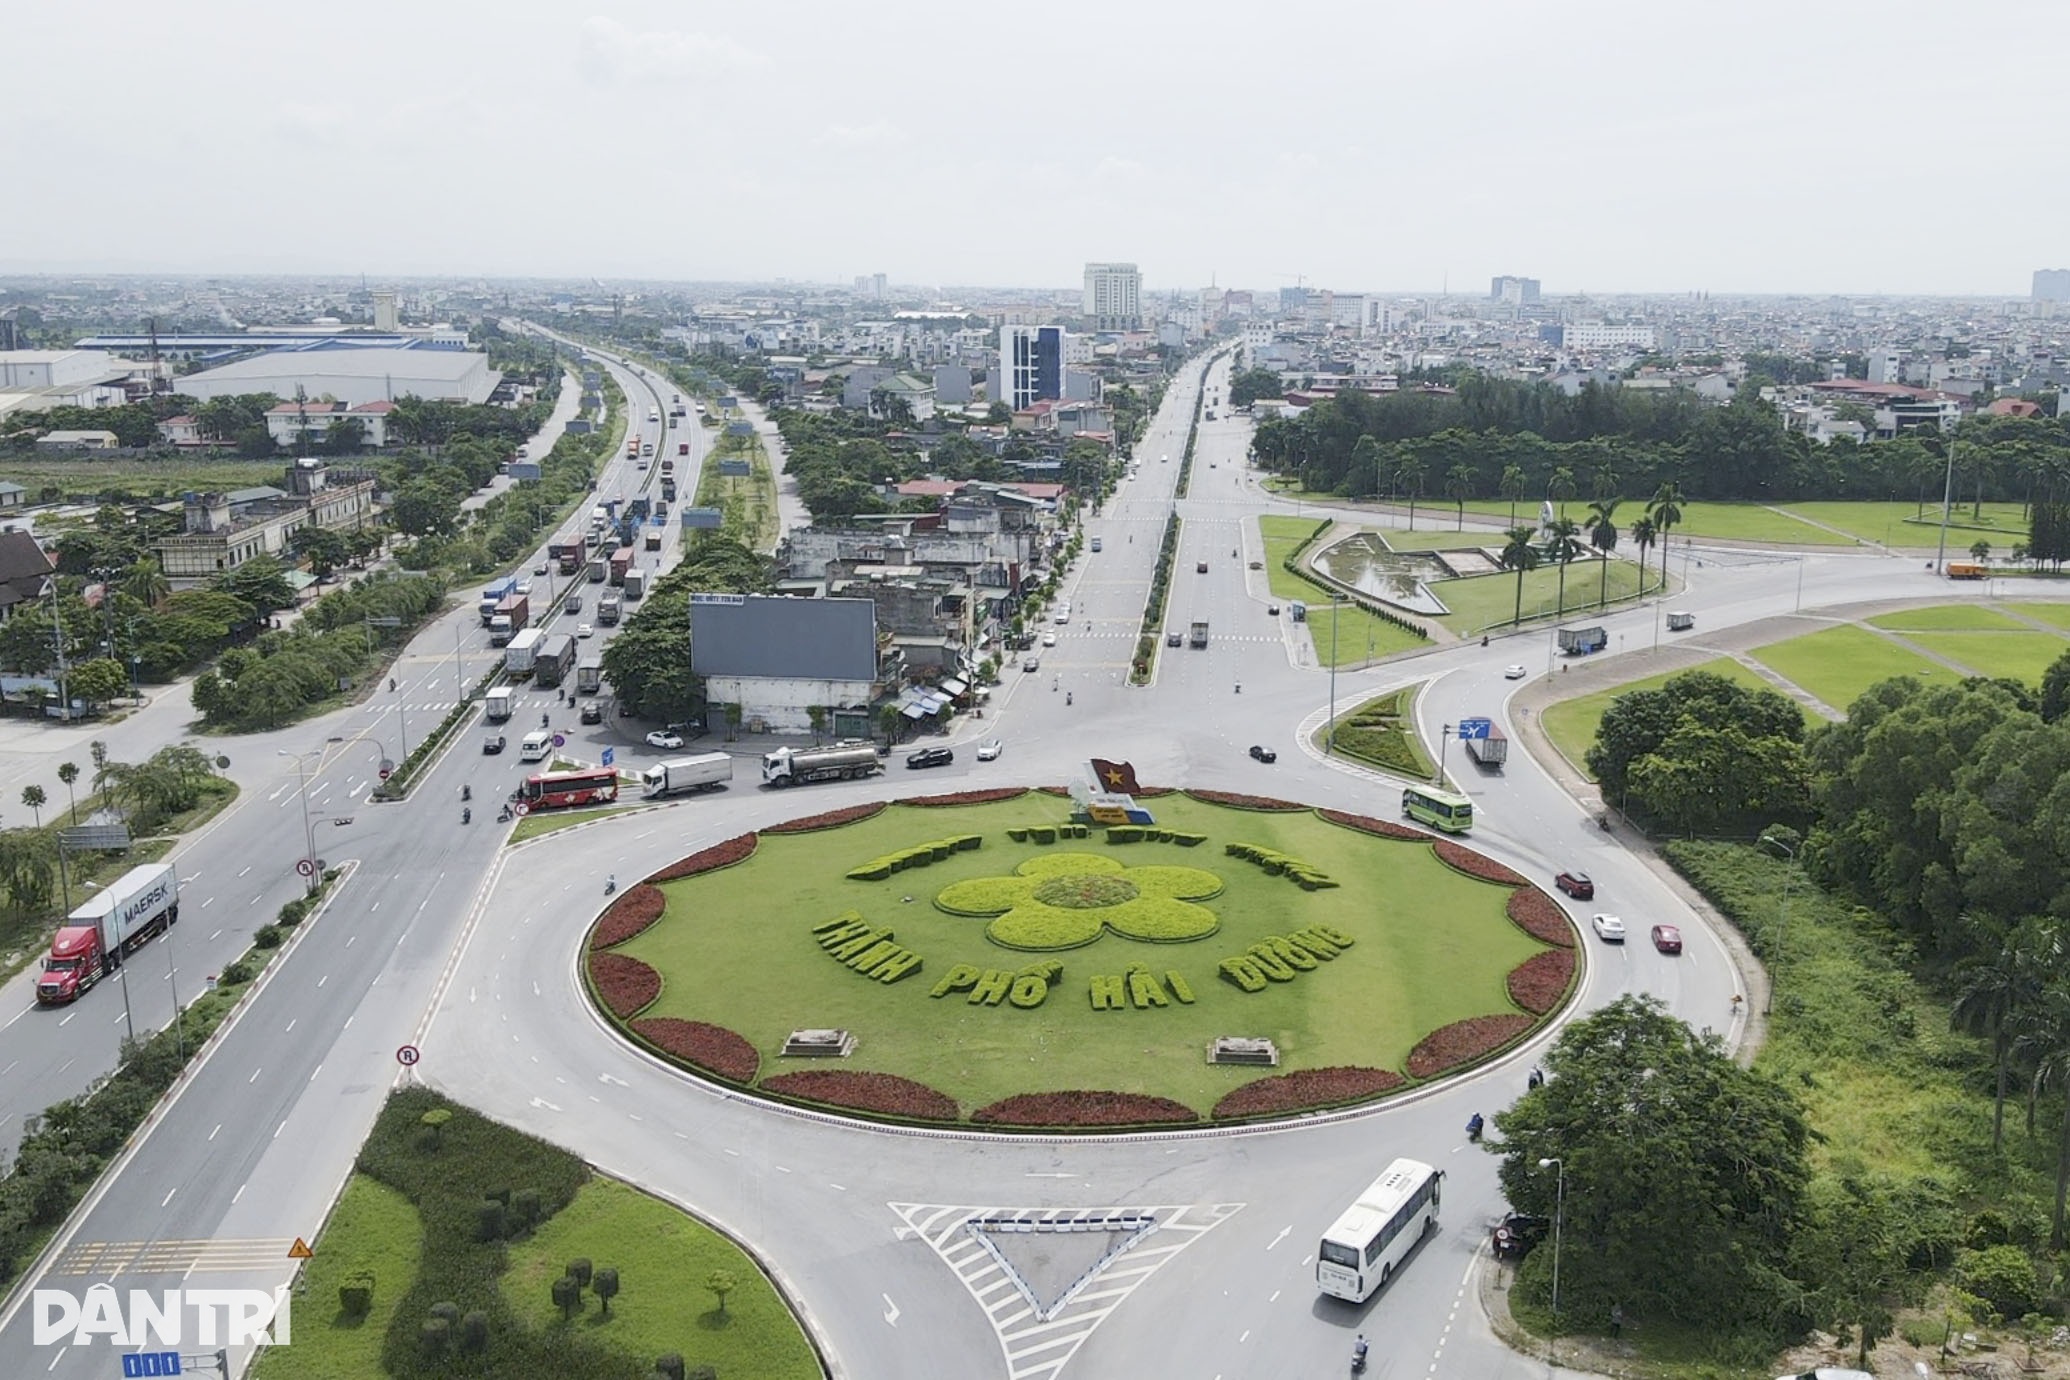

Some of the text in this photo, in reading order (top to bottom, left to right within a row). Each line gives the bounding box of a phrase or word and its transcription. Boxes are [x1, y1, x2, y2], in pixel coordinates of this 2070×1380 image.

[124, 882, 169, 925] MAERSK
[929, 958, 1063, 1009] PHỐ
[1089, 960, 1195, 1010] HẢI
